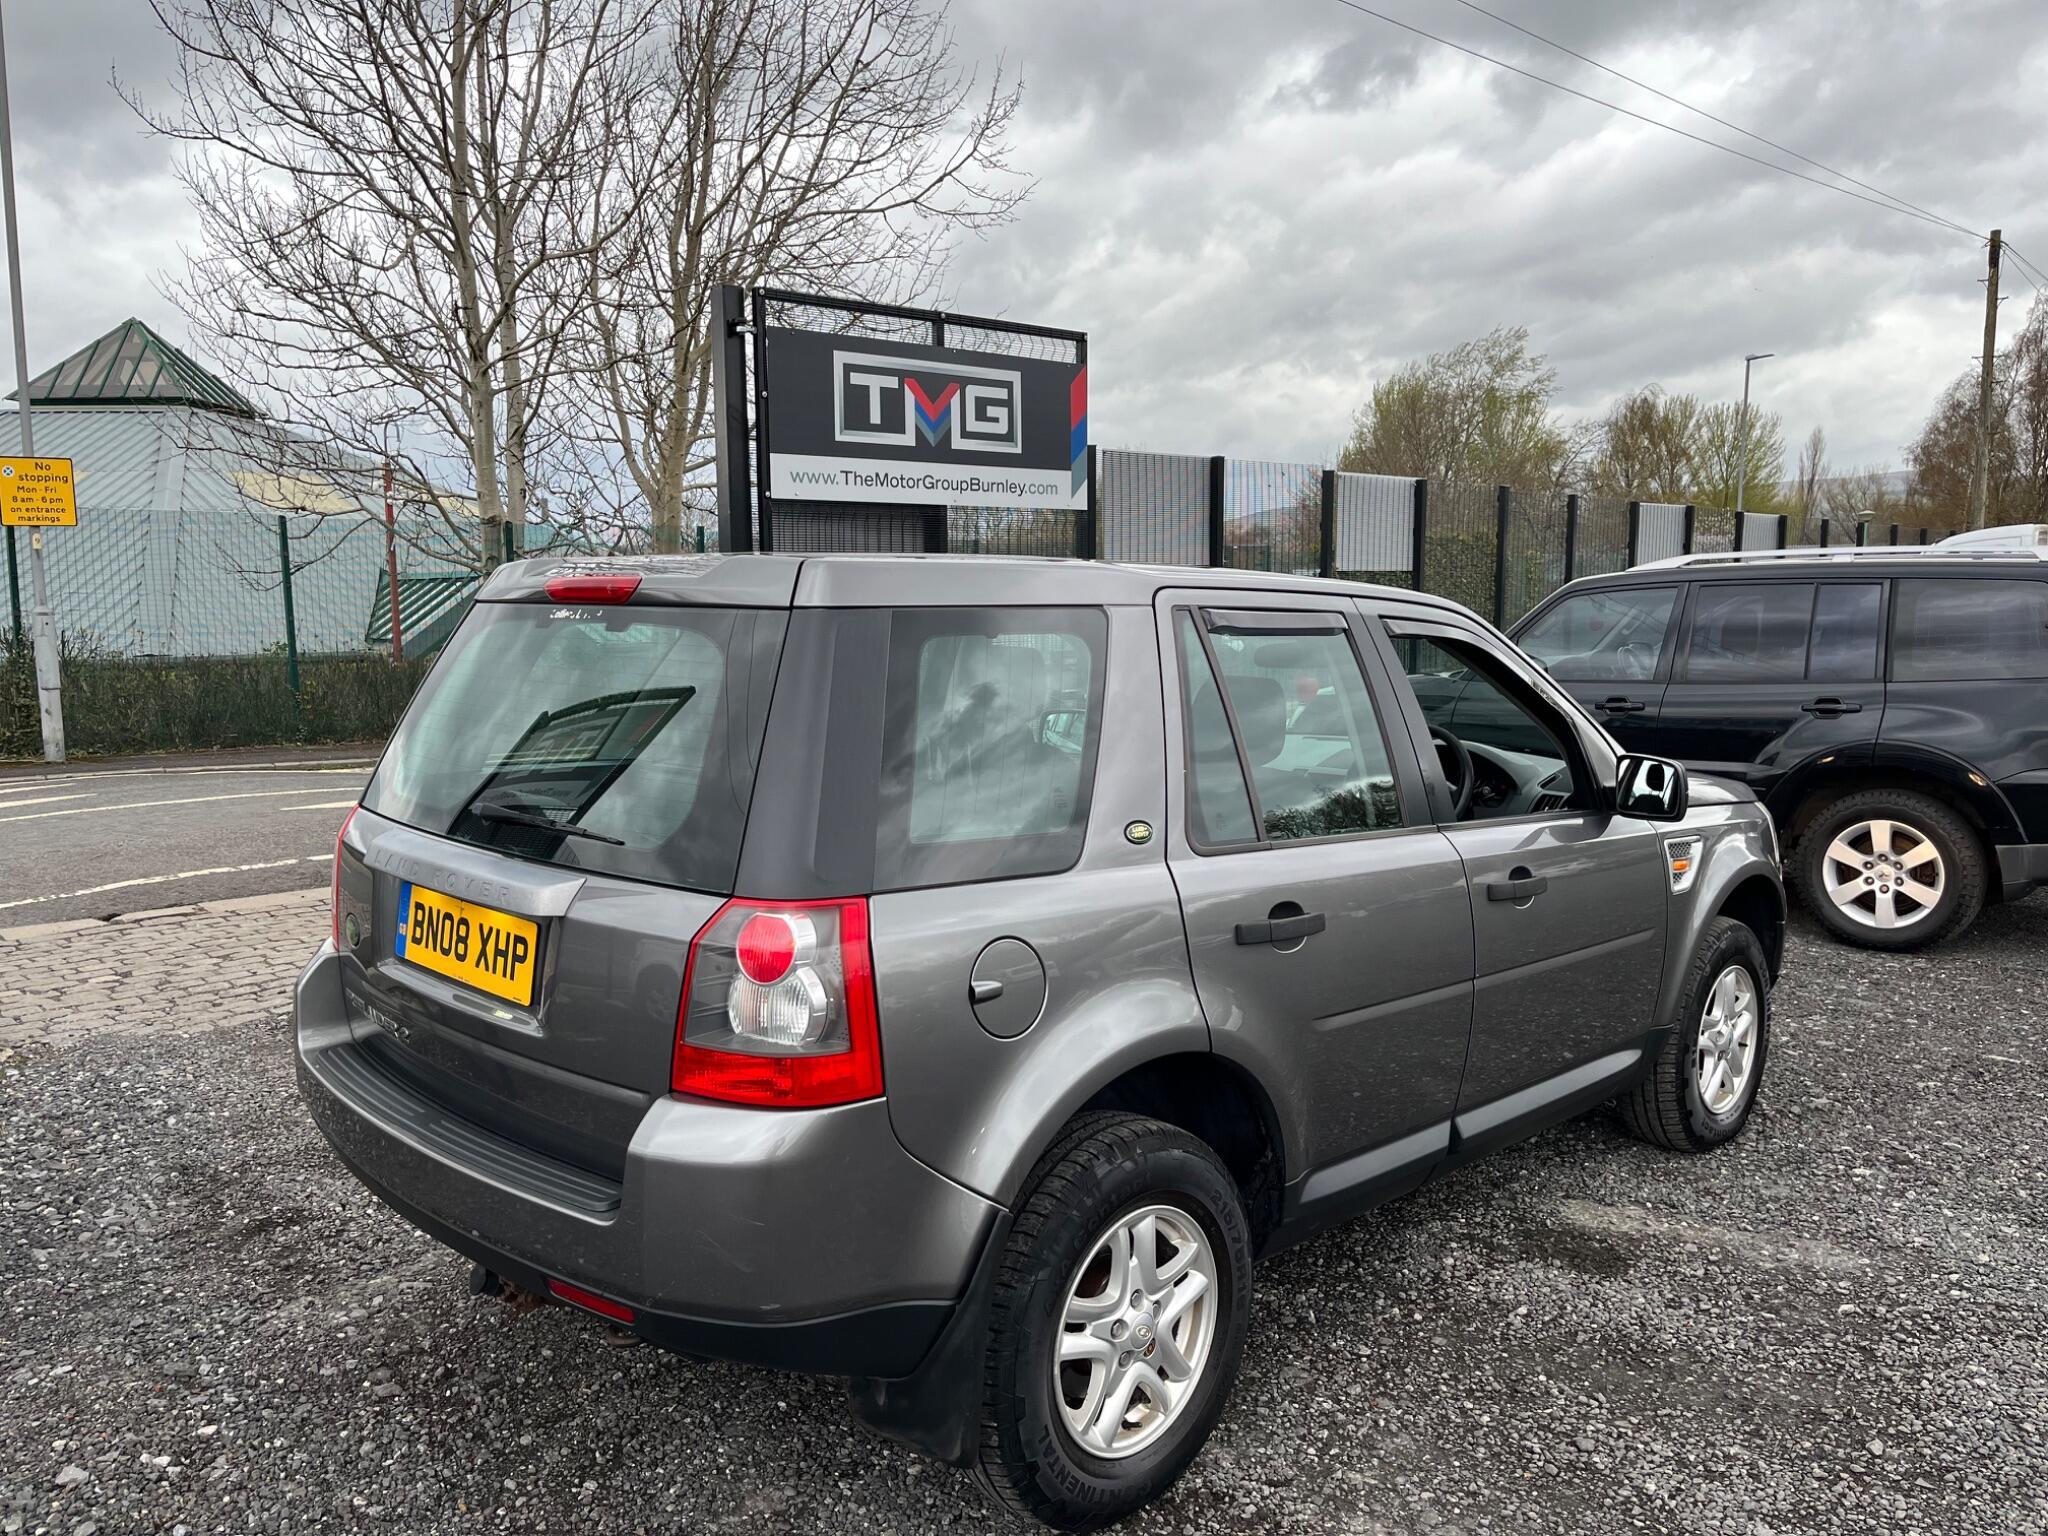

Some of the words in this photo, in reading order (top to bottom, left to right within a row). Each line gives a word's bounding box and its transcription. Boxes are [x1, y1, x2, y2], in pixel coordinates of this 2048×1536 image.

[850, 371, 1009, 447] TMG
[35, 462, 51, 471] No
[18, 473, 68, 483] stopping
[789, 469, 1059, 497] www.TheMotorGroupBurnley.com
[49, 497, 64, 505] pm
[18, 515, 61, 523] markings
[411, 901, 470, 963] BN08
[474, 922, 529, 981] XHP
